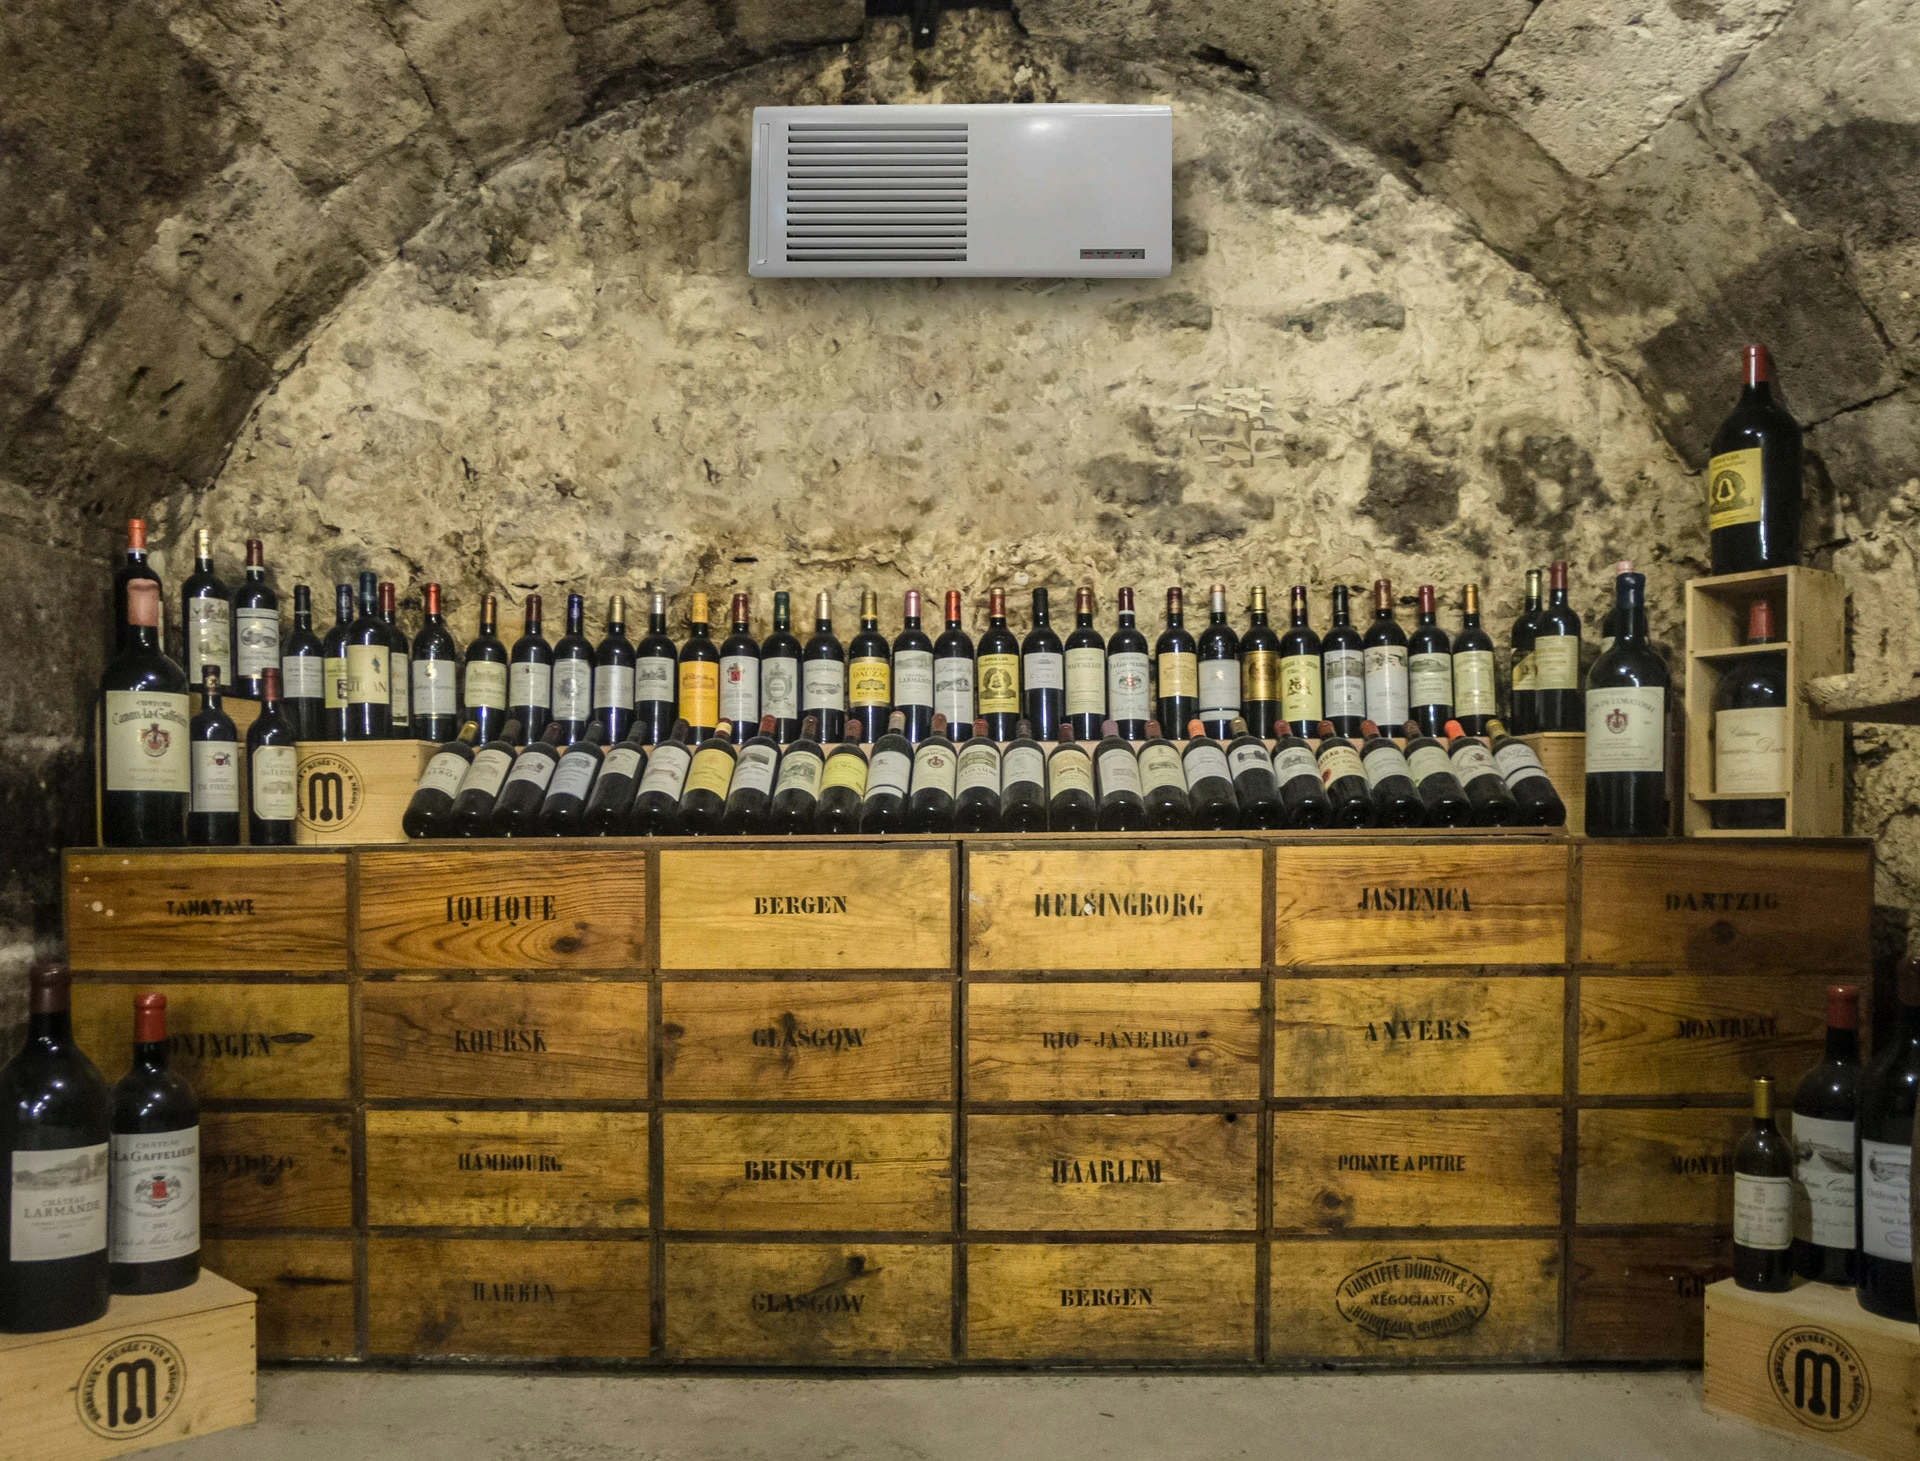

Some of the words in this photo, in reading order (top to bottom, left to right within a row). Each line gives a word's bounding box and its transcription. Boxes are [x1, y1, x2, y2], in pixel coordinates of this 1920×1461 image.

[447, 896, 557, 927] IQUIQUE
[753, 896, 848, 915] BERGEN
[1034, 890, 1204, 918] HELSINGBORG
[1665, 892, 1780, 912] DANTZIG
[752, 1027, 868, 1052] GLASGOW
[1364, 1019, 1471, 1041] ANVERS
[455, 1029, 548, 1053] KOURSK
[459, 1153, 563, 1172] HAMBOURG
[744, 1160, 860, 1181] BRISTOL
[1052, 1159, 1162, 1183] HAARLEM
[1338, 1154, 1400, 1172] POINTE
[1403, 1156, 1415, 1172] A
[1418, 1155, 1466, 1172] PITRE
[24, 1200, 100, 1219] LARMANDE
[473, 1282, 555, 1303] HARBIN
[1060, 1287, 1153, 1307] BERGEN
[751, 1293, 866, 1314] GLASGOW
